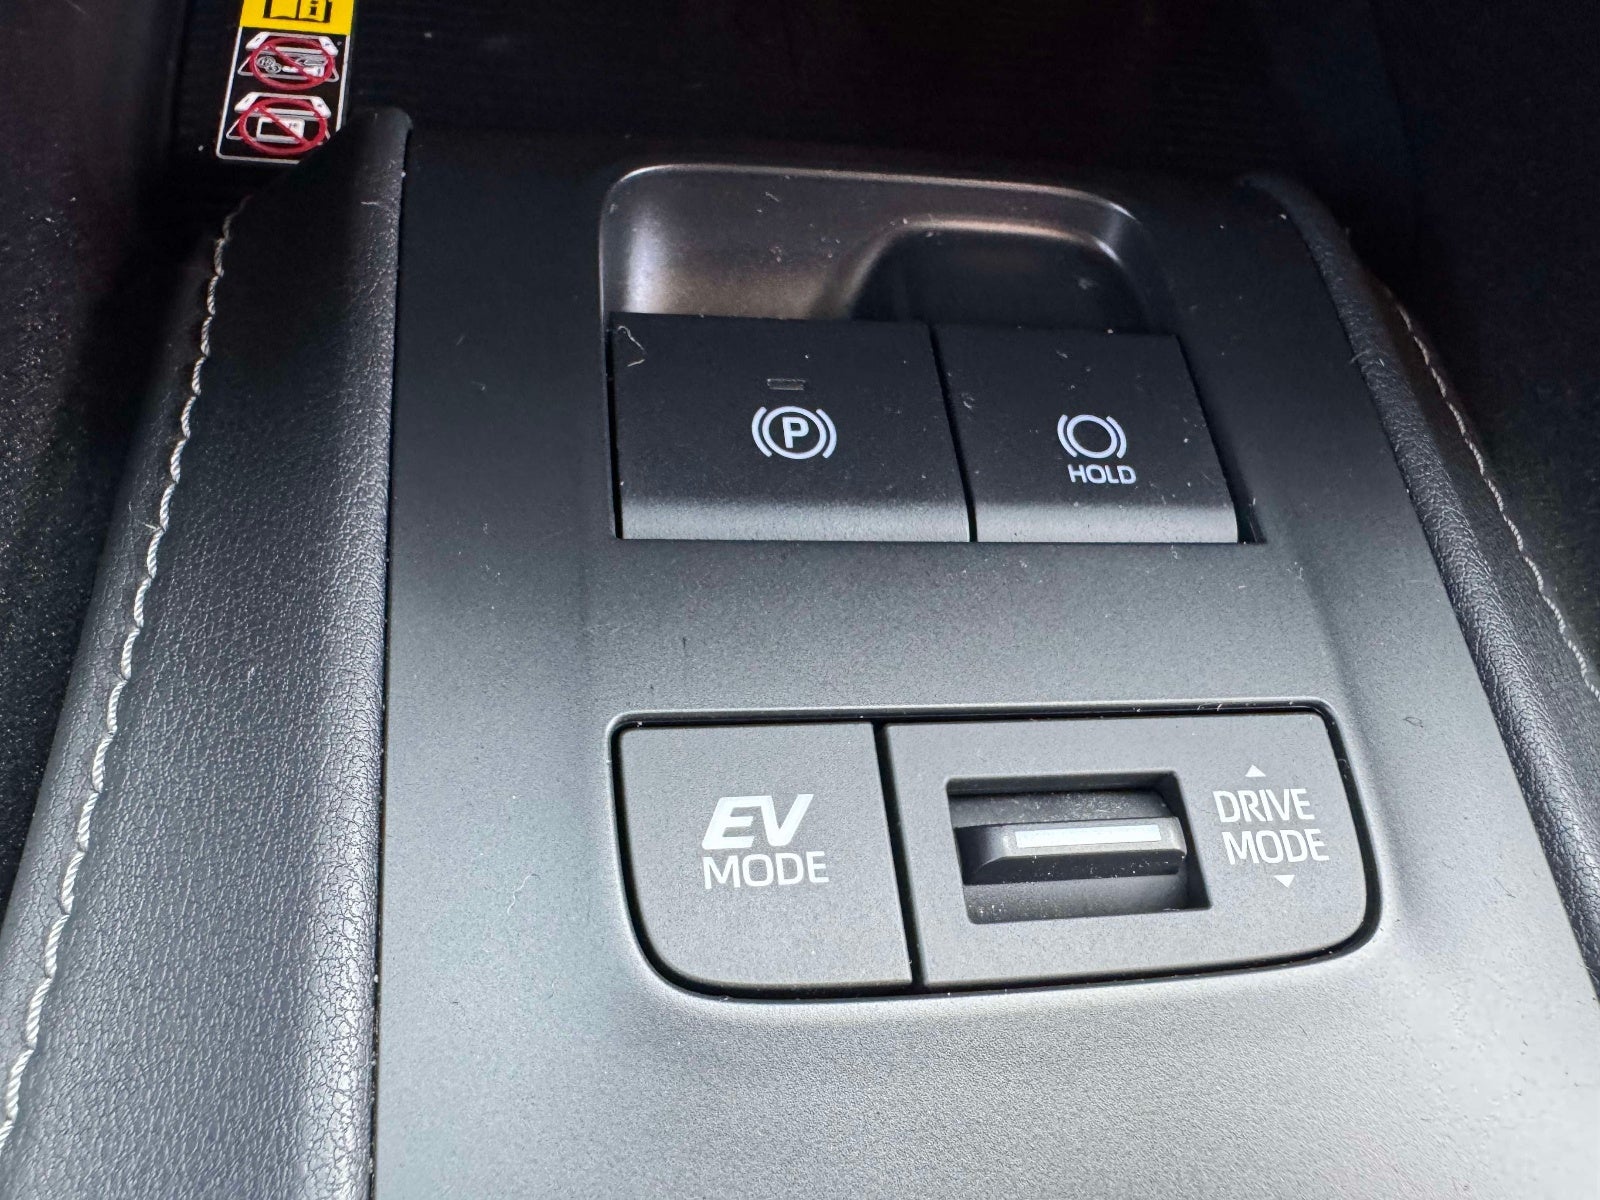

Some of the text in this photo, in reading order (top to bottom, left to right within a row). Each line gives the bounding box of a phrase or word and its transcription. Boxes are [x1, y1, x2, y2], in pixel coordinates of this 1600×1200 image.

[782, 416, 809, 449] P
[1067, 463, 1137, 485] HOLD
[701, 793, 814, 850] EV
[1212, 788, 1316, 823] DRIVE
[1221, 828, 1330, 865] MODE
[702, 850, 830, 890] MODE
